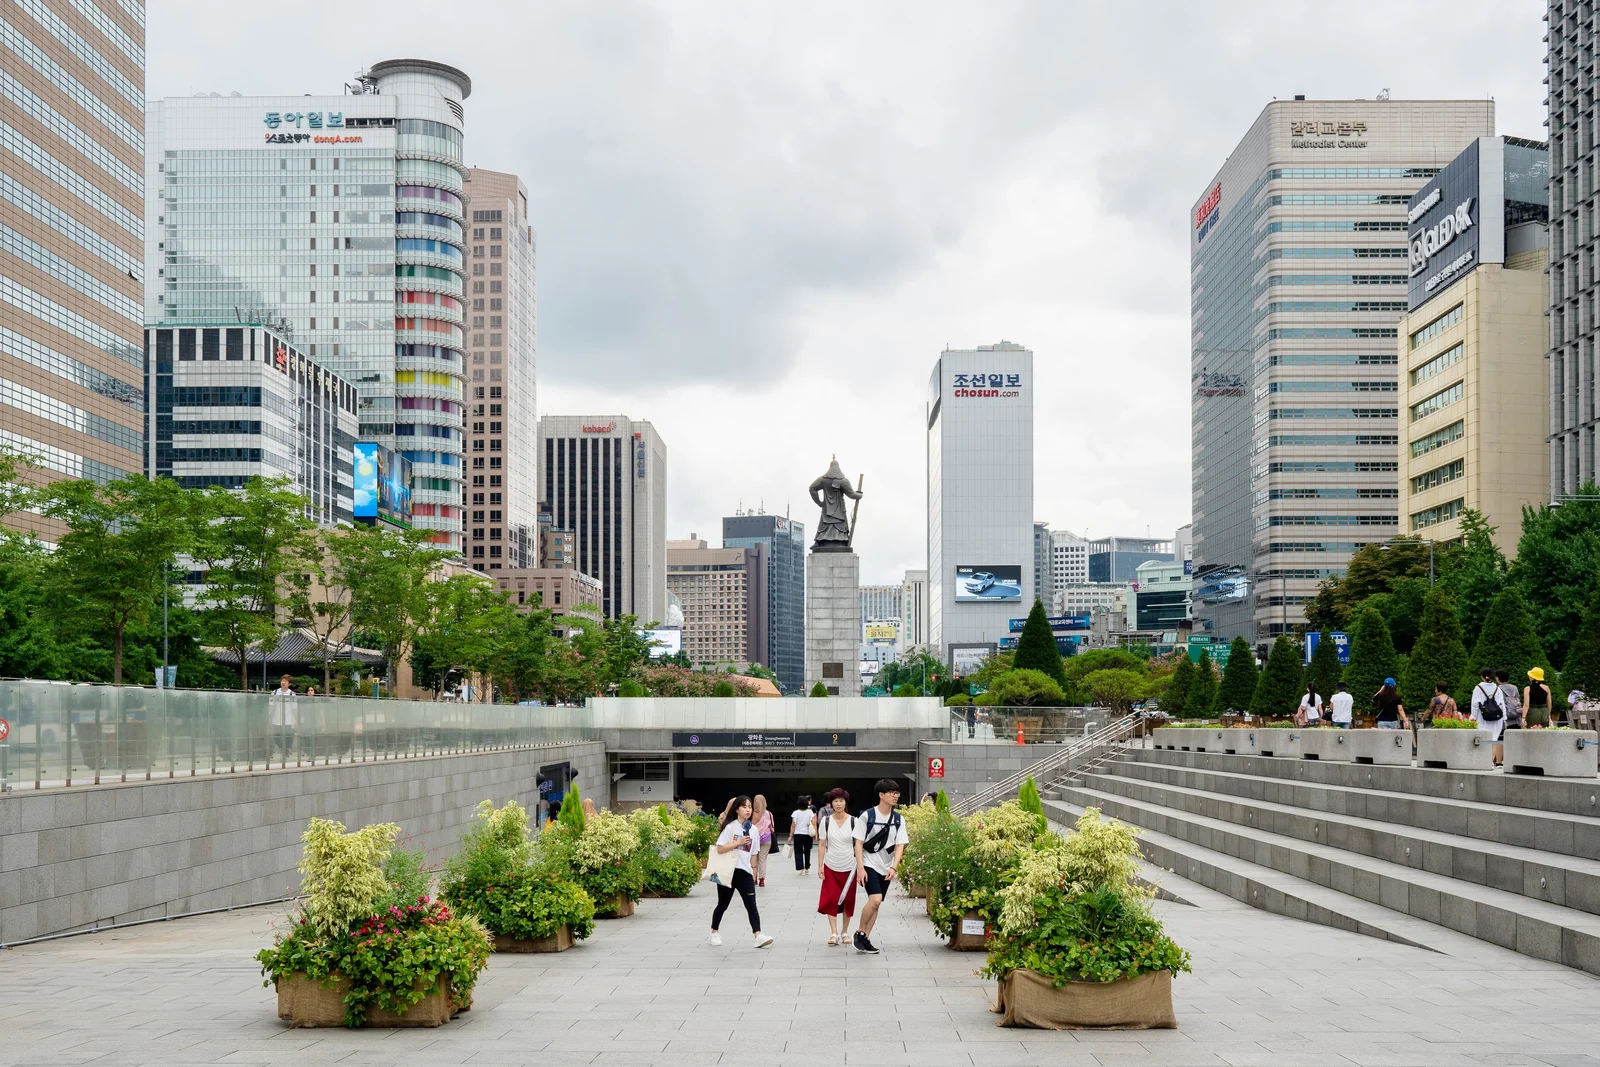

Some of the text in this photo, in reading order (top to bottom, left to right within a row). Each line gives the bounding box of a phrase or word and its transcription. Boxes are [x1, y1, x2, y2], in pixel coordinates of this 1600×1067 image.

[263, 112, 345, 129] 동아일보
[1291, 121, 1368, 136] 감리교본부
[313, 135, 363, 144] dongA.com
[1291, 140, 1368, 148] Methodist Center
[1423, 214, 1456, 258] QLED
[1455, 198, 1473, 234] 8K
[953, 374, 1022, 387] 조선일보
[954, 388, 1019, 397] chosun.com
[582, 425, 612, 433] kobaco
[832, 733, 838, 741] 9
